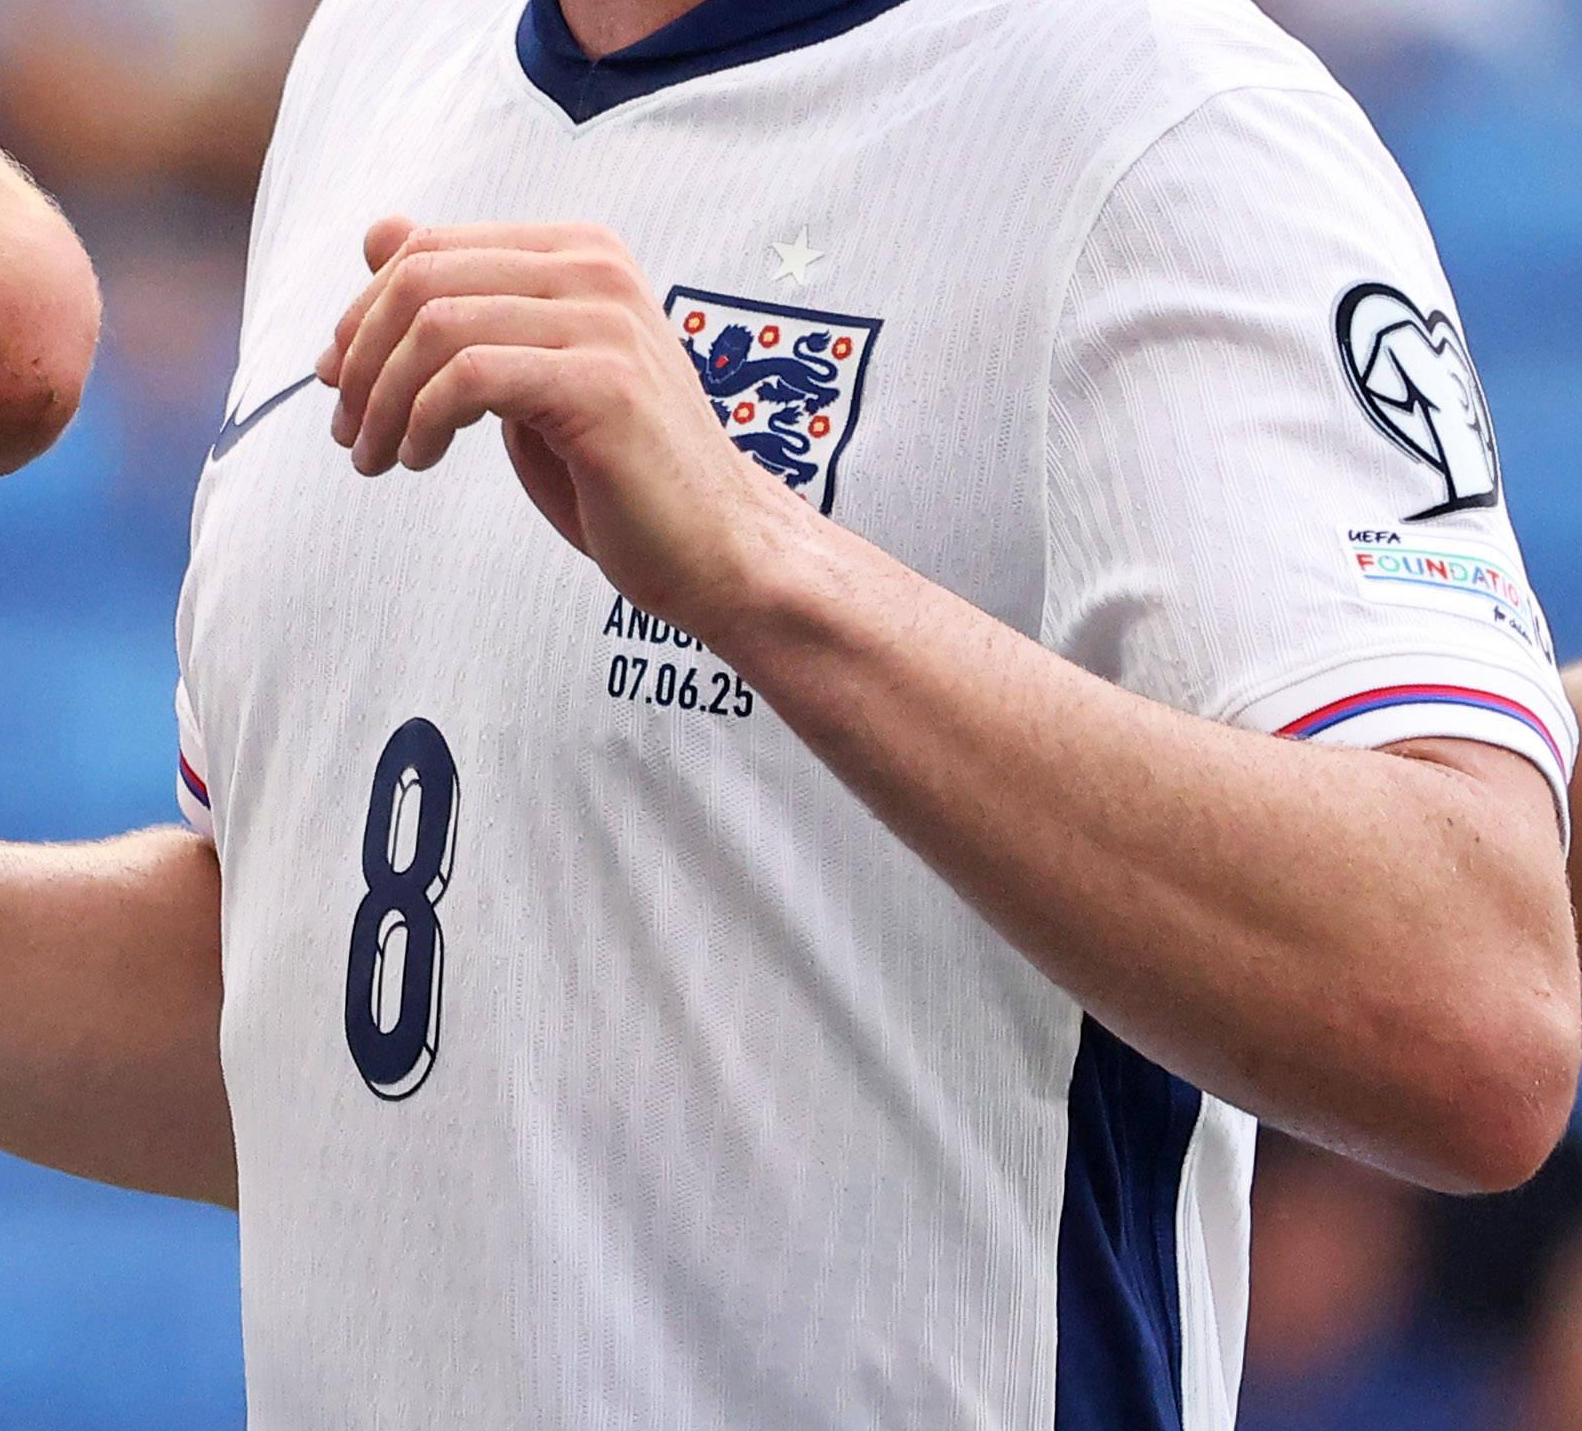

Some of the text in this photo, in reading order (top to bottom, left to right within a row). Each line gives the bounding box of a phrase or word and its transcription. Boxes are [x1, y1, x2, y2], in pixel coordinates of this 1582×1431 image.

[1348, 528, 1402, 545] UEFA
[1355, 552, 1528, 614] FOUNDATIO
[602, 593, 705, 652] AND
[607, 653, 754, 719] 07.06.25
[344, 716, 461, 1102] 8
